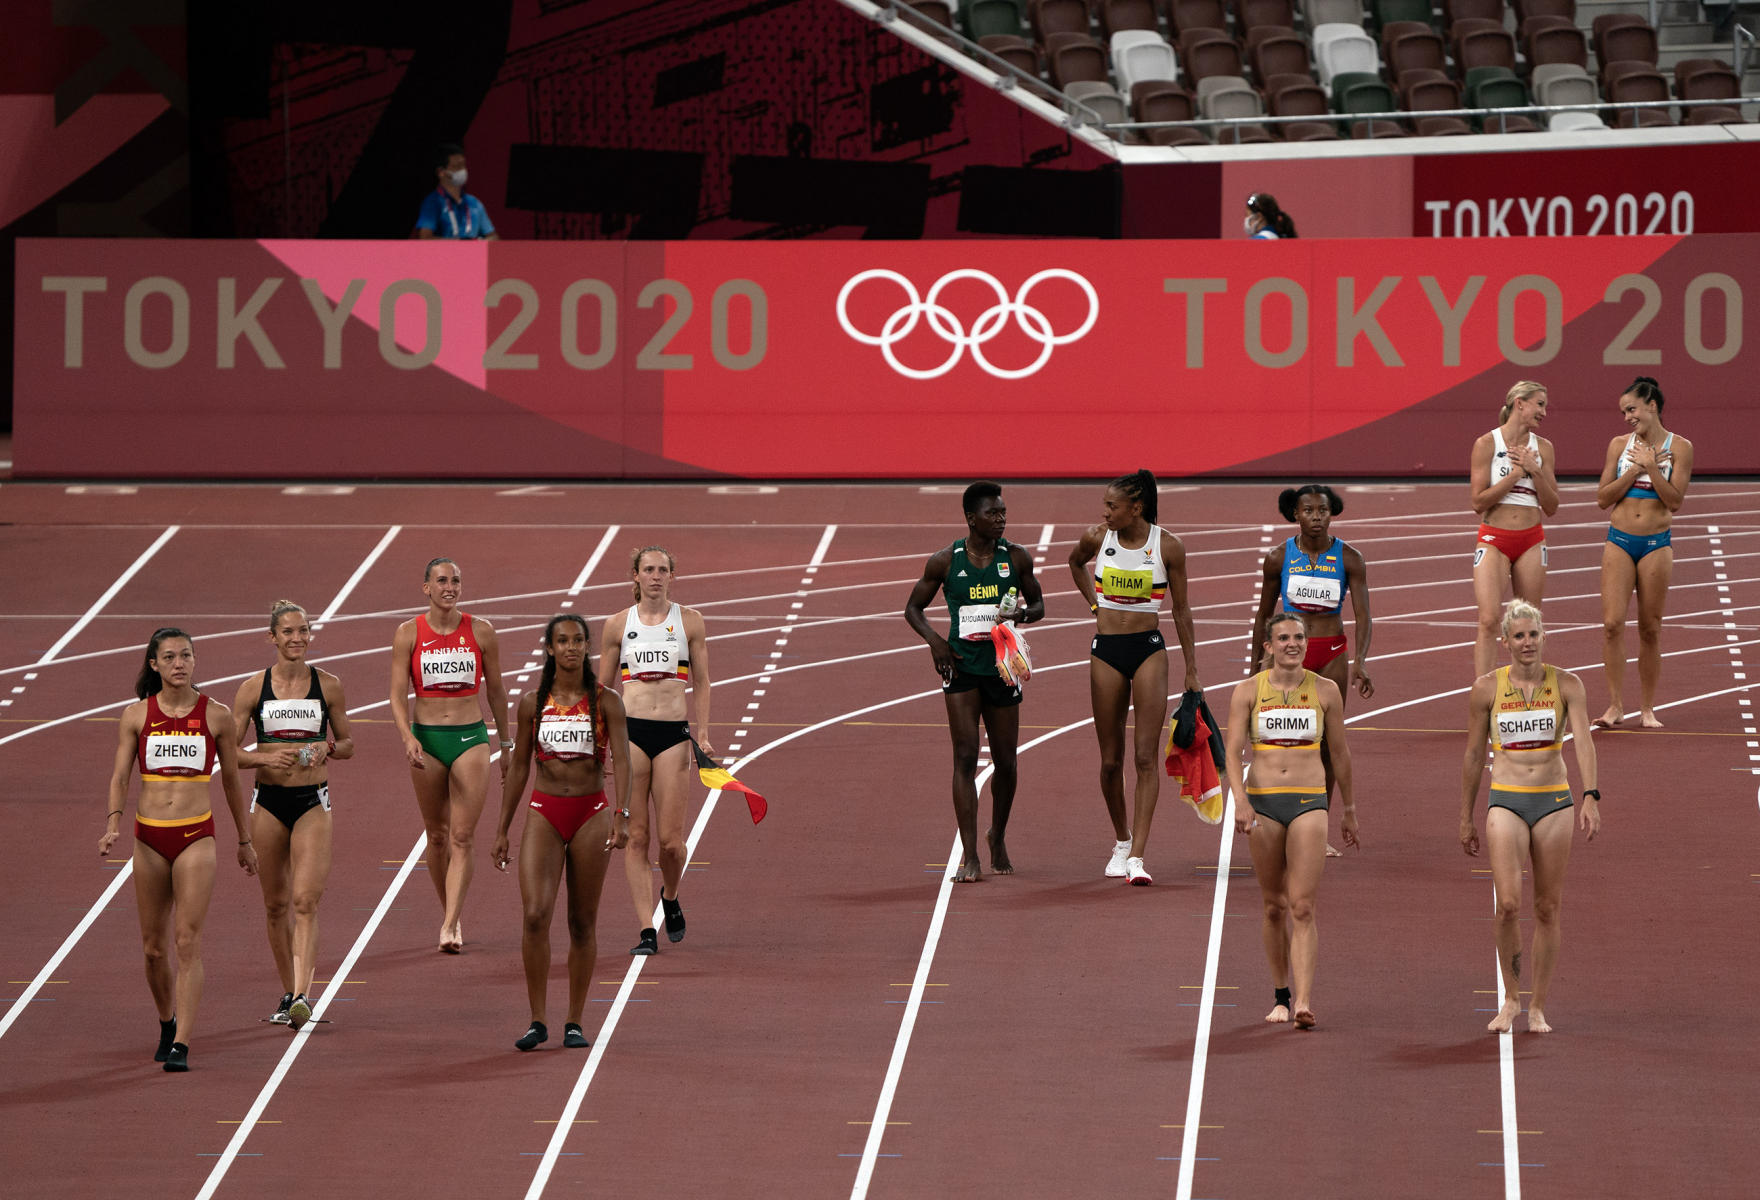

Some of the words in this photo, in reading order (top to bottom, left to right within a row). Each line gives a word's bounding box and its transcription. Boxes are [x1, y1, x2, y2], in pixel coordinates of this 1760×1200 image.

[1424, 195, 1573, 238] TOKYO
[1585, 190, 1695, 237] 2020
[42, 276, 444, 370] TOKYO
[481, 278, 769, 371] 2020
[1164, 274, 1563, 369] TOKYO
[1602, 272, 1744, 367] 20
[1289, 564, 1337, 574] COLOMBIA
[1110, 575, 1143, 590] THIAM
[969, 583, 999, 599] BÉNIN
[1296, 587, 1331, 600] AGUILAR
[961, 614, 999, 623] AHOUANWA
[634, 650, 669, 663] VIDTS
[423, 660, 475, 674] KRIZSAN
[268, 708, 316, 719] VORONINA
[1266, 717, 1309, 730] GRIMM
[1499, 717, 1554, 733] SCHAFER
[542, 730, 593, 743] VICENTE
[154, 744, 197, 757] ZHENG
